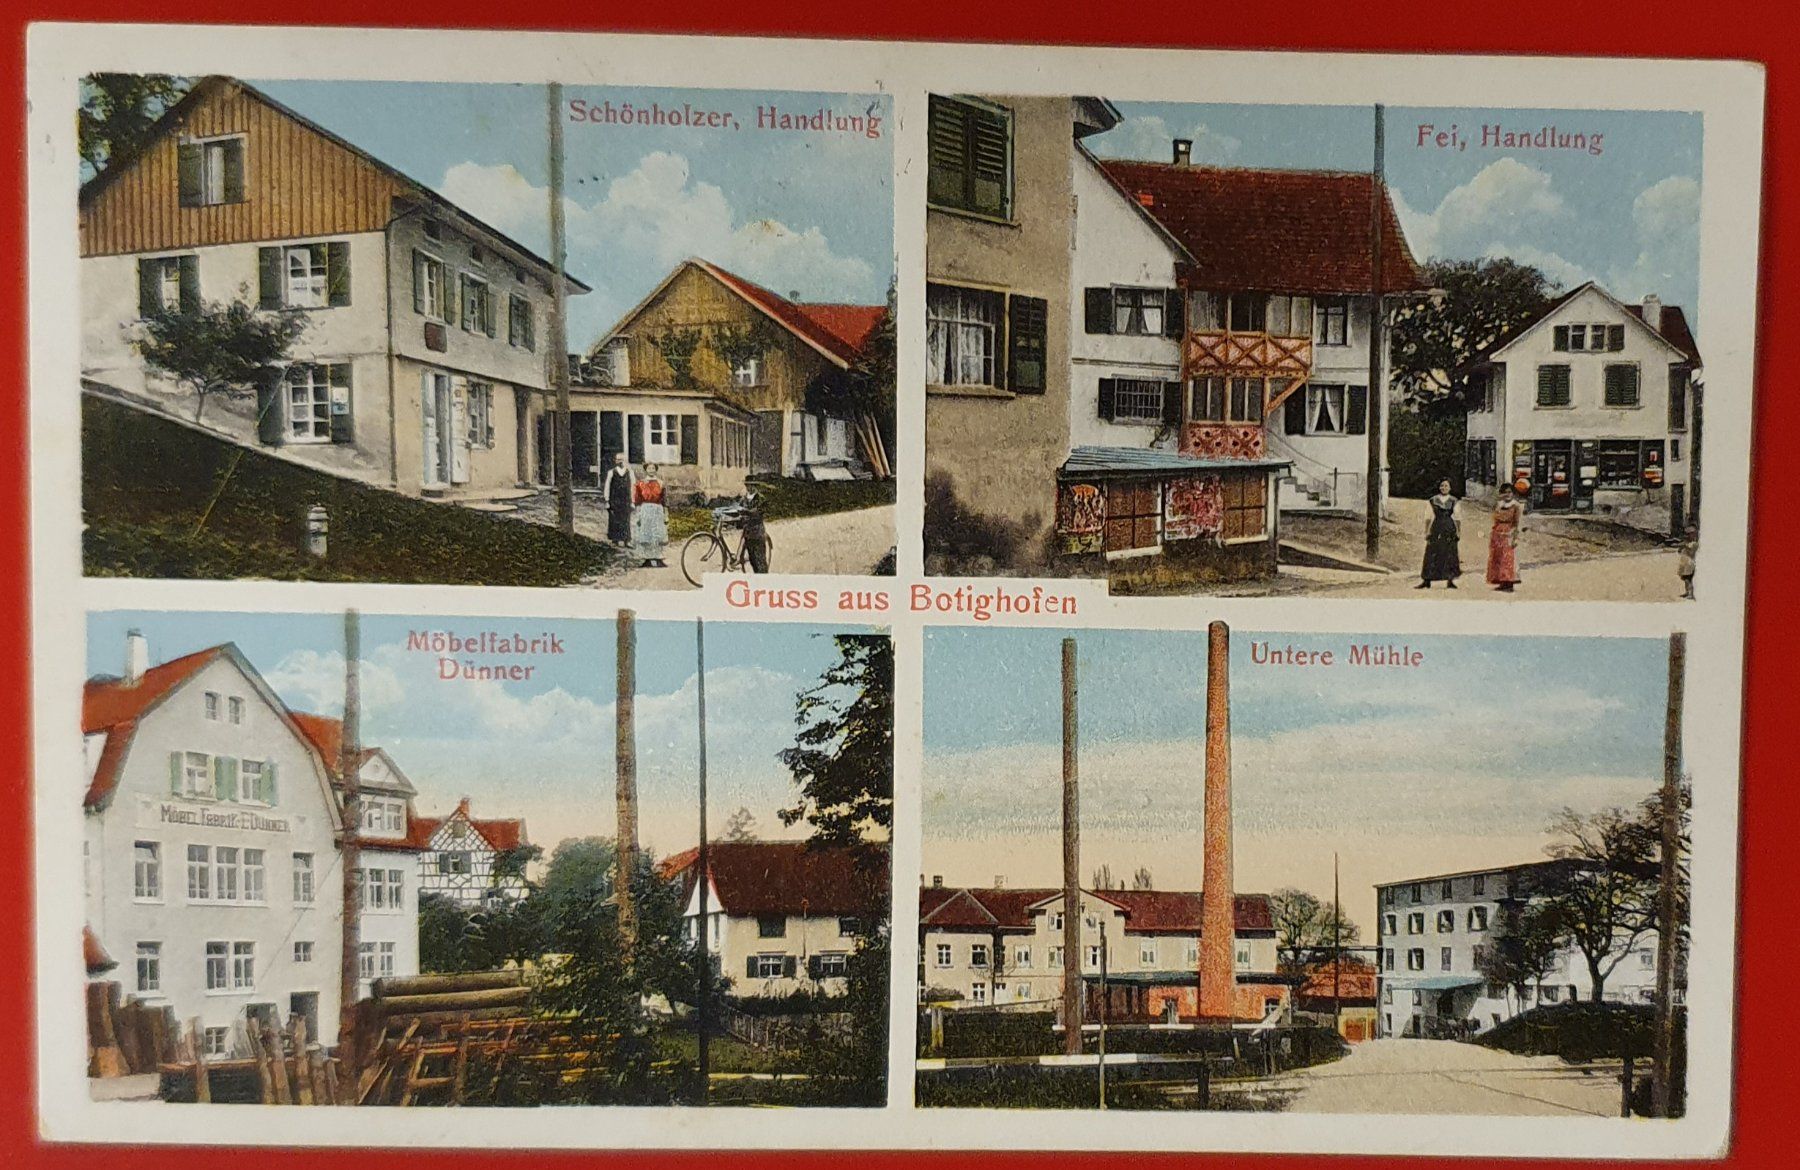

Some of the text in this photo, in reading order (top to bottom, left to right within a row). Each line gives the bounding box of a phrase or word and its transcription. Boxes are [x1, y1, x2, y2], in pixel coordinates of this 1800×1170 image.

[570, 99, 882, 139] Schönholzer, Handlung
[1417, 124, 1603, 154] Fei, Handlung
[725, 579, 1078, 623] Gruss aus Botighofen
[407, 632, 565, 655] Möbelfabrik
[1251, 642, 1425, 668] Untere Mühle
[437, 657, 535, 682] Dünner
